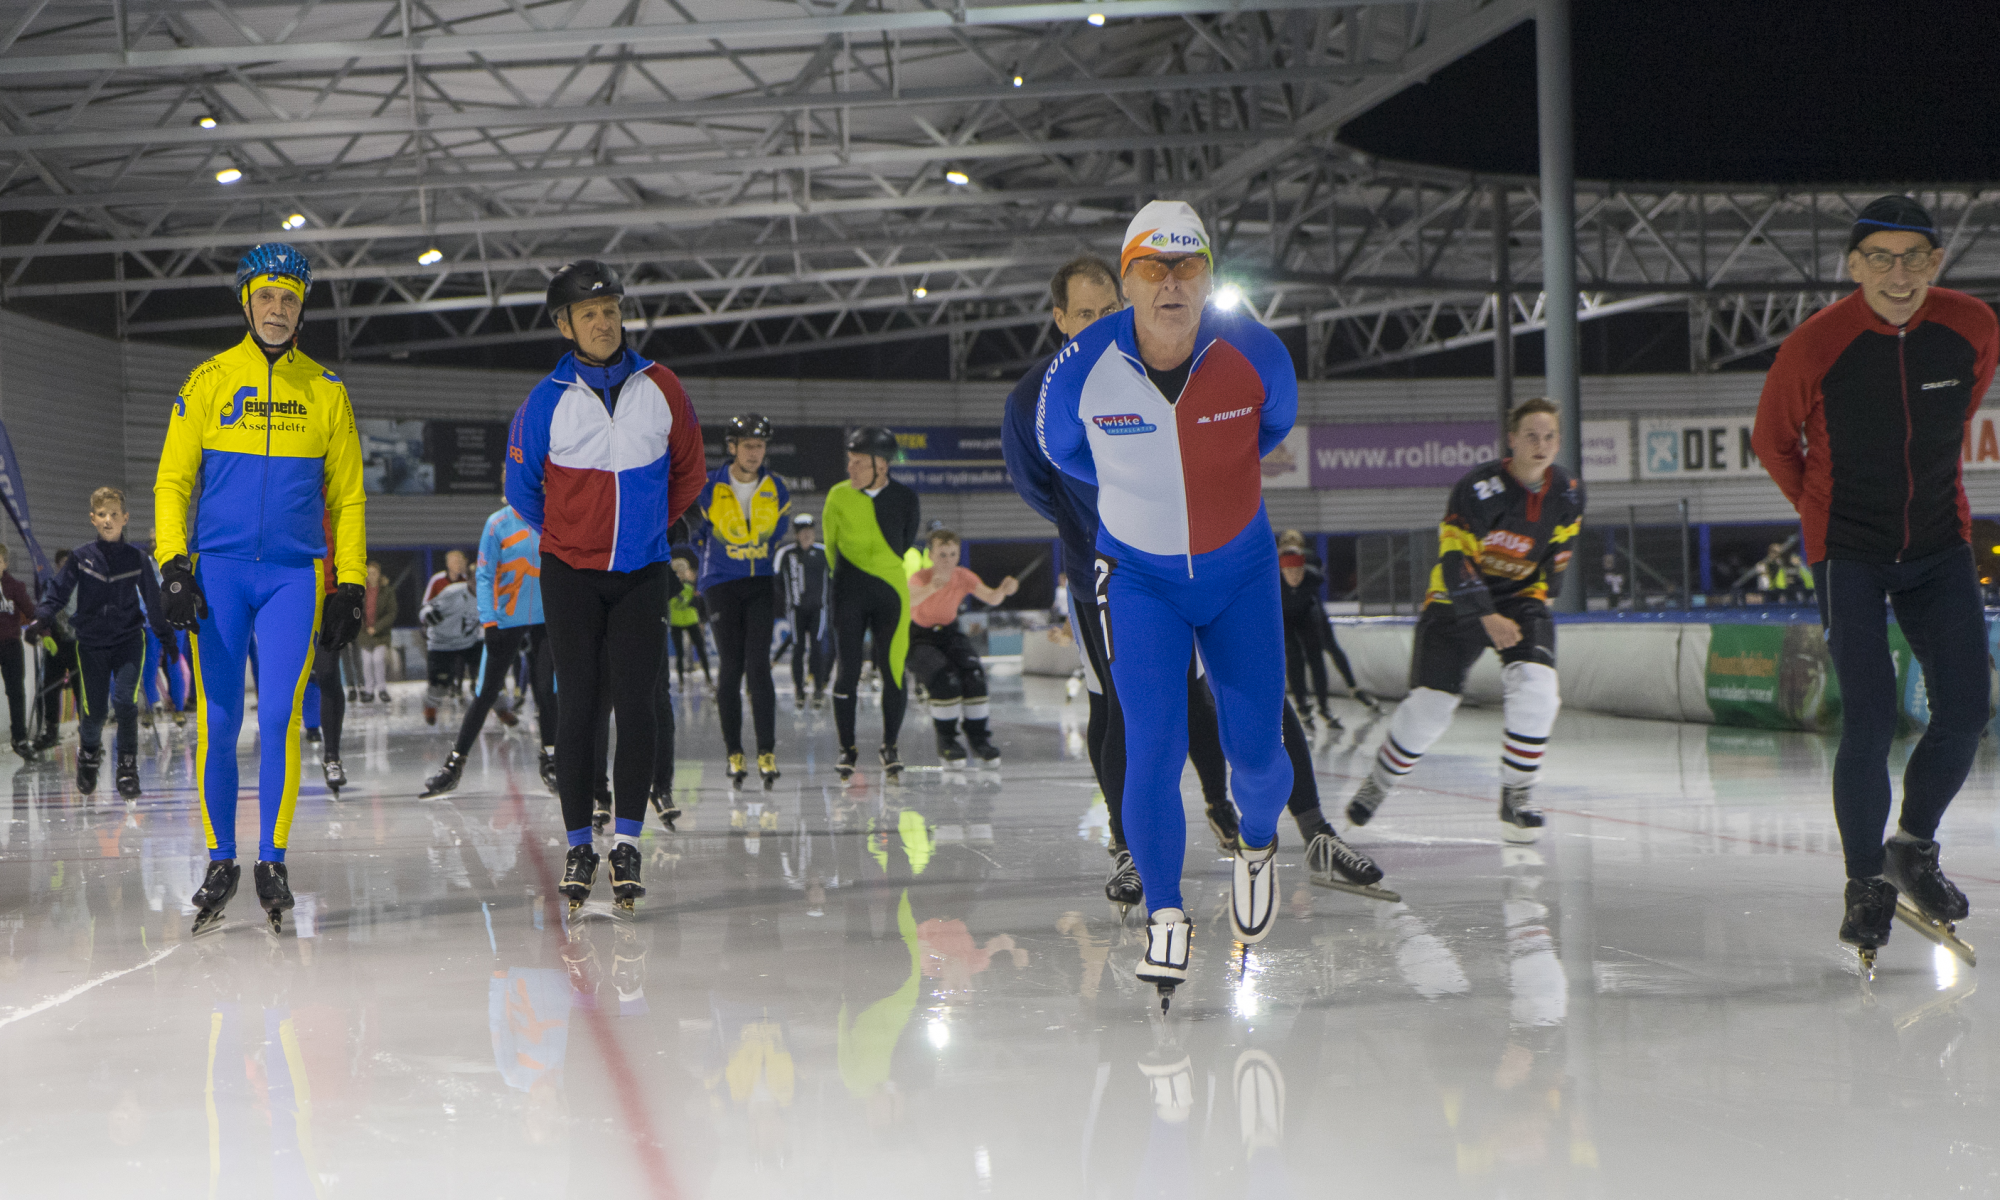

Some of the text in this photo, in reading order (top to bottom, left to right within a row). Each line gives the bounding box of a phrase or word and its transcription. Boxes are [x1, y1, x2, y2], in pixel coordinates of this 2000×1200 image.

[1170, 232, 1200, 247] kpn
[1213, 406, 1253, 422] HUNTER
[238, 421, 307, 433] Assendelft
[1095, 416, 1140, 429] Twiske
[1682, 428, 1727, 470] DE
[1473, 475, 1506, 500] 24
